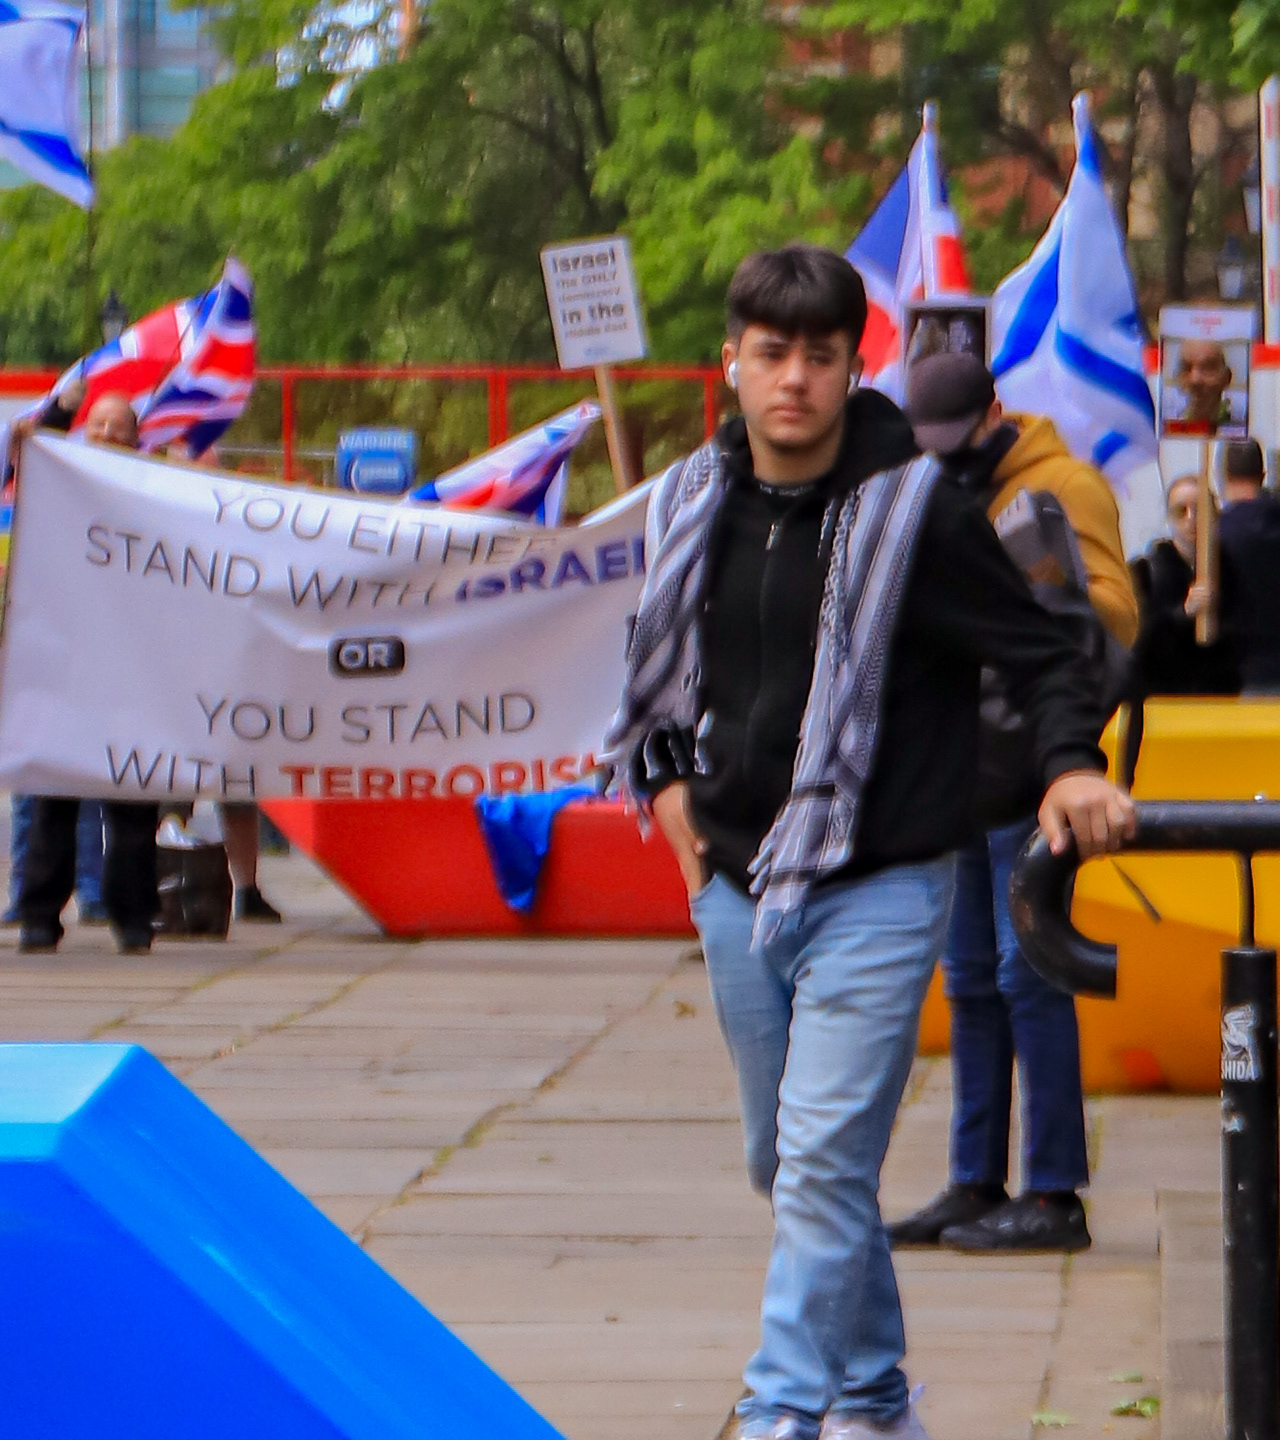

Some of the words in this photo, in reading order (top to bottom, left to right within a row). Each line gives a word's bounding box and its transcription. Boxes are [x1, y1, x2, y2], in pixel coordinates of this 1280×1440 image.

[552, 247, 616, 273] Israel
[588, 303, 625, 321] the
[212, 488, 331, 541] YOU
[85, 524, 261, 598] STAND
[286, 564, 437, 612] WITH
[338, 640, 390, 670] OR
[196, 692, 315, 742] YOU
[340, 691, 536, 744] STAND
[105, 743, 256, 797] WITH
[278, 752, 605, 799] TERRORIS
